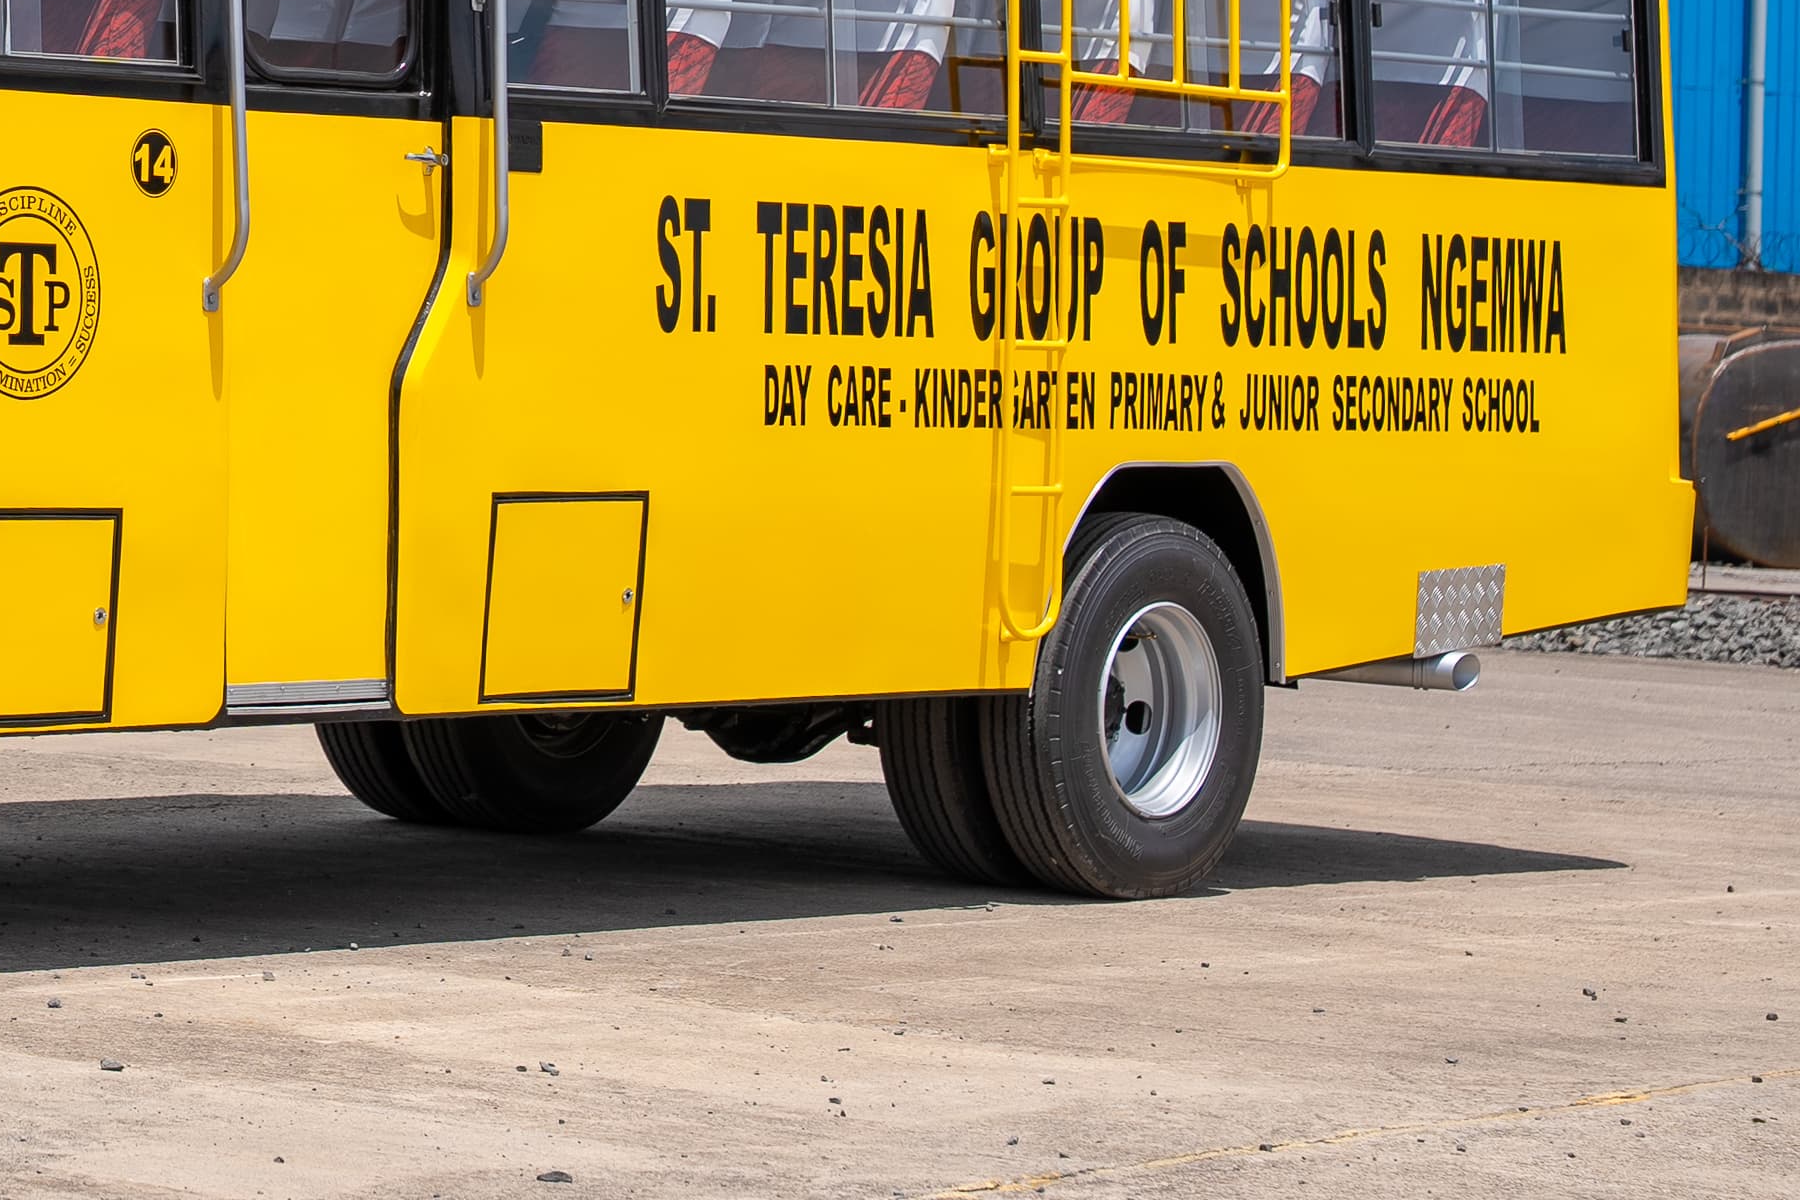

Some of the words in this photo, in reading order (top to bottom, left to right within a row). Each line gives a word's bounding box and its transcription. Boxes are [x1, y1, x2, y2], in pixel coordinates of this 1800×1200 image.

[134, 143, 174, 184] 14
[75, 265, 97, 354] SUCCESS
[655, 194, 716, 334] ST.
[756, 201, 935, 339] TERESIA
[1140, 219, 1187, 347] OF
[1220, 222, 1388, 351] SCHOOLS
[1420, 232, 1567, 355] NGEMWA
[764, 364, 812, 427] DAY
[827, 365, 892, 428] CARE
[1239, 373, 1320, 432] JUNIOR
[1332, 374, 1454, 433] SECONDARY
[1462, 377, 1540, 434] SCHOOL
